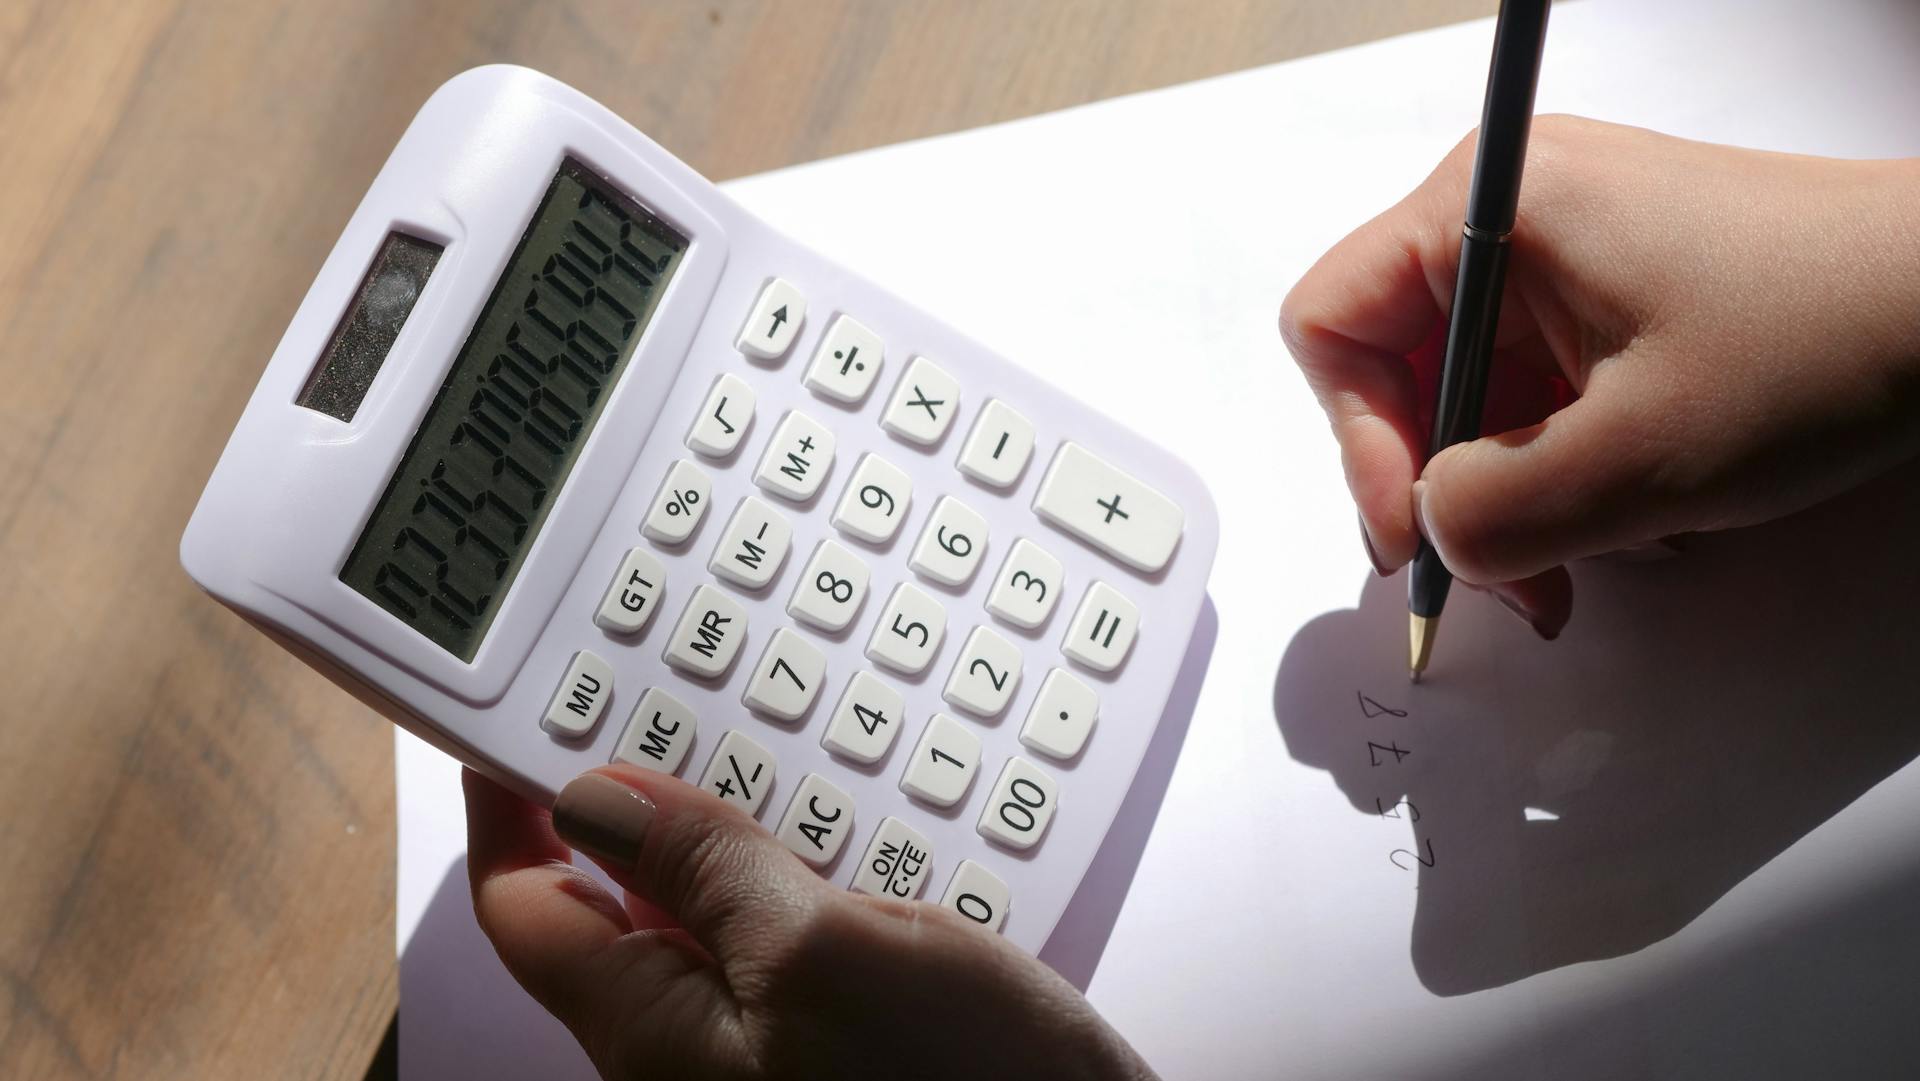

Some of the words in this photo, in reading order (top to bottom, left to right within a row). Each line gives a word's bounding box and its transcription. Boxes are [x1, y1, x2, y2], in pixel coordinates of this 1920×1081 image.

[781, 437, 813, 481] M+
[666, 490, 699, 515] %
[861, 486, 894, 516] 9
[938, 526, 971, 556] 6
[621, 569, 656, 614] GT
[817, 572, 852, 603] 8
[1012, 571, 1045, 602] 3
[690, 611, 733, 660] MR
[892, 616, 928, 647] 5
[770, 658, 805, 691] 7
[970, 659, 1007, 691] 2
[566, 673, 602, 717] MU
[635, 706, 683, 762] MC
[854, 704, 887, 735] 4
[931, 748, 964, 768] 1
[1000, 779, 1048, 834] 00
[798, 796, 845, 850] AC
[872, 842, 900, 876] ON
[956, 894, 992, 924] 0
